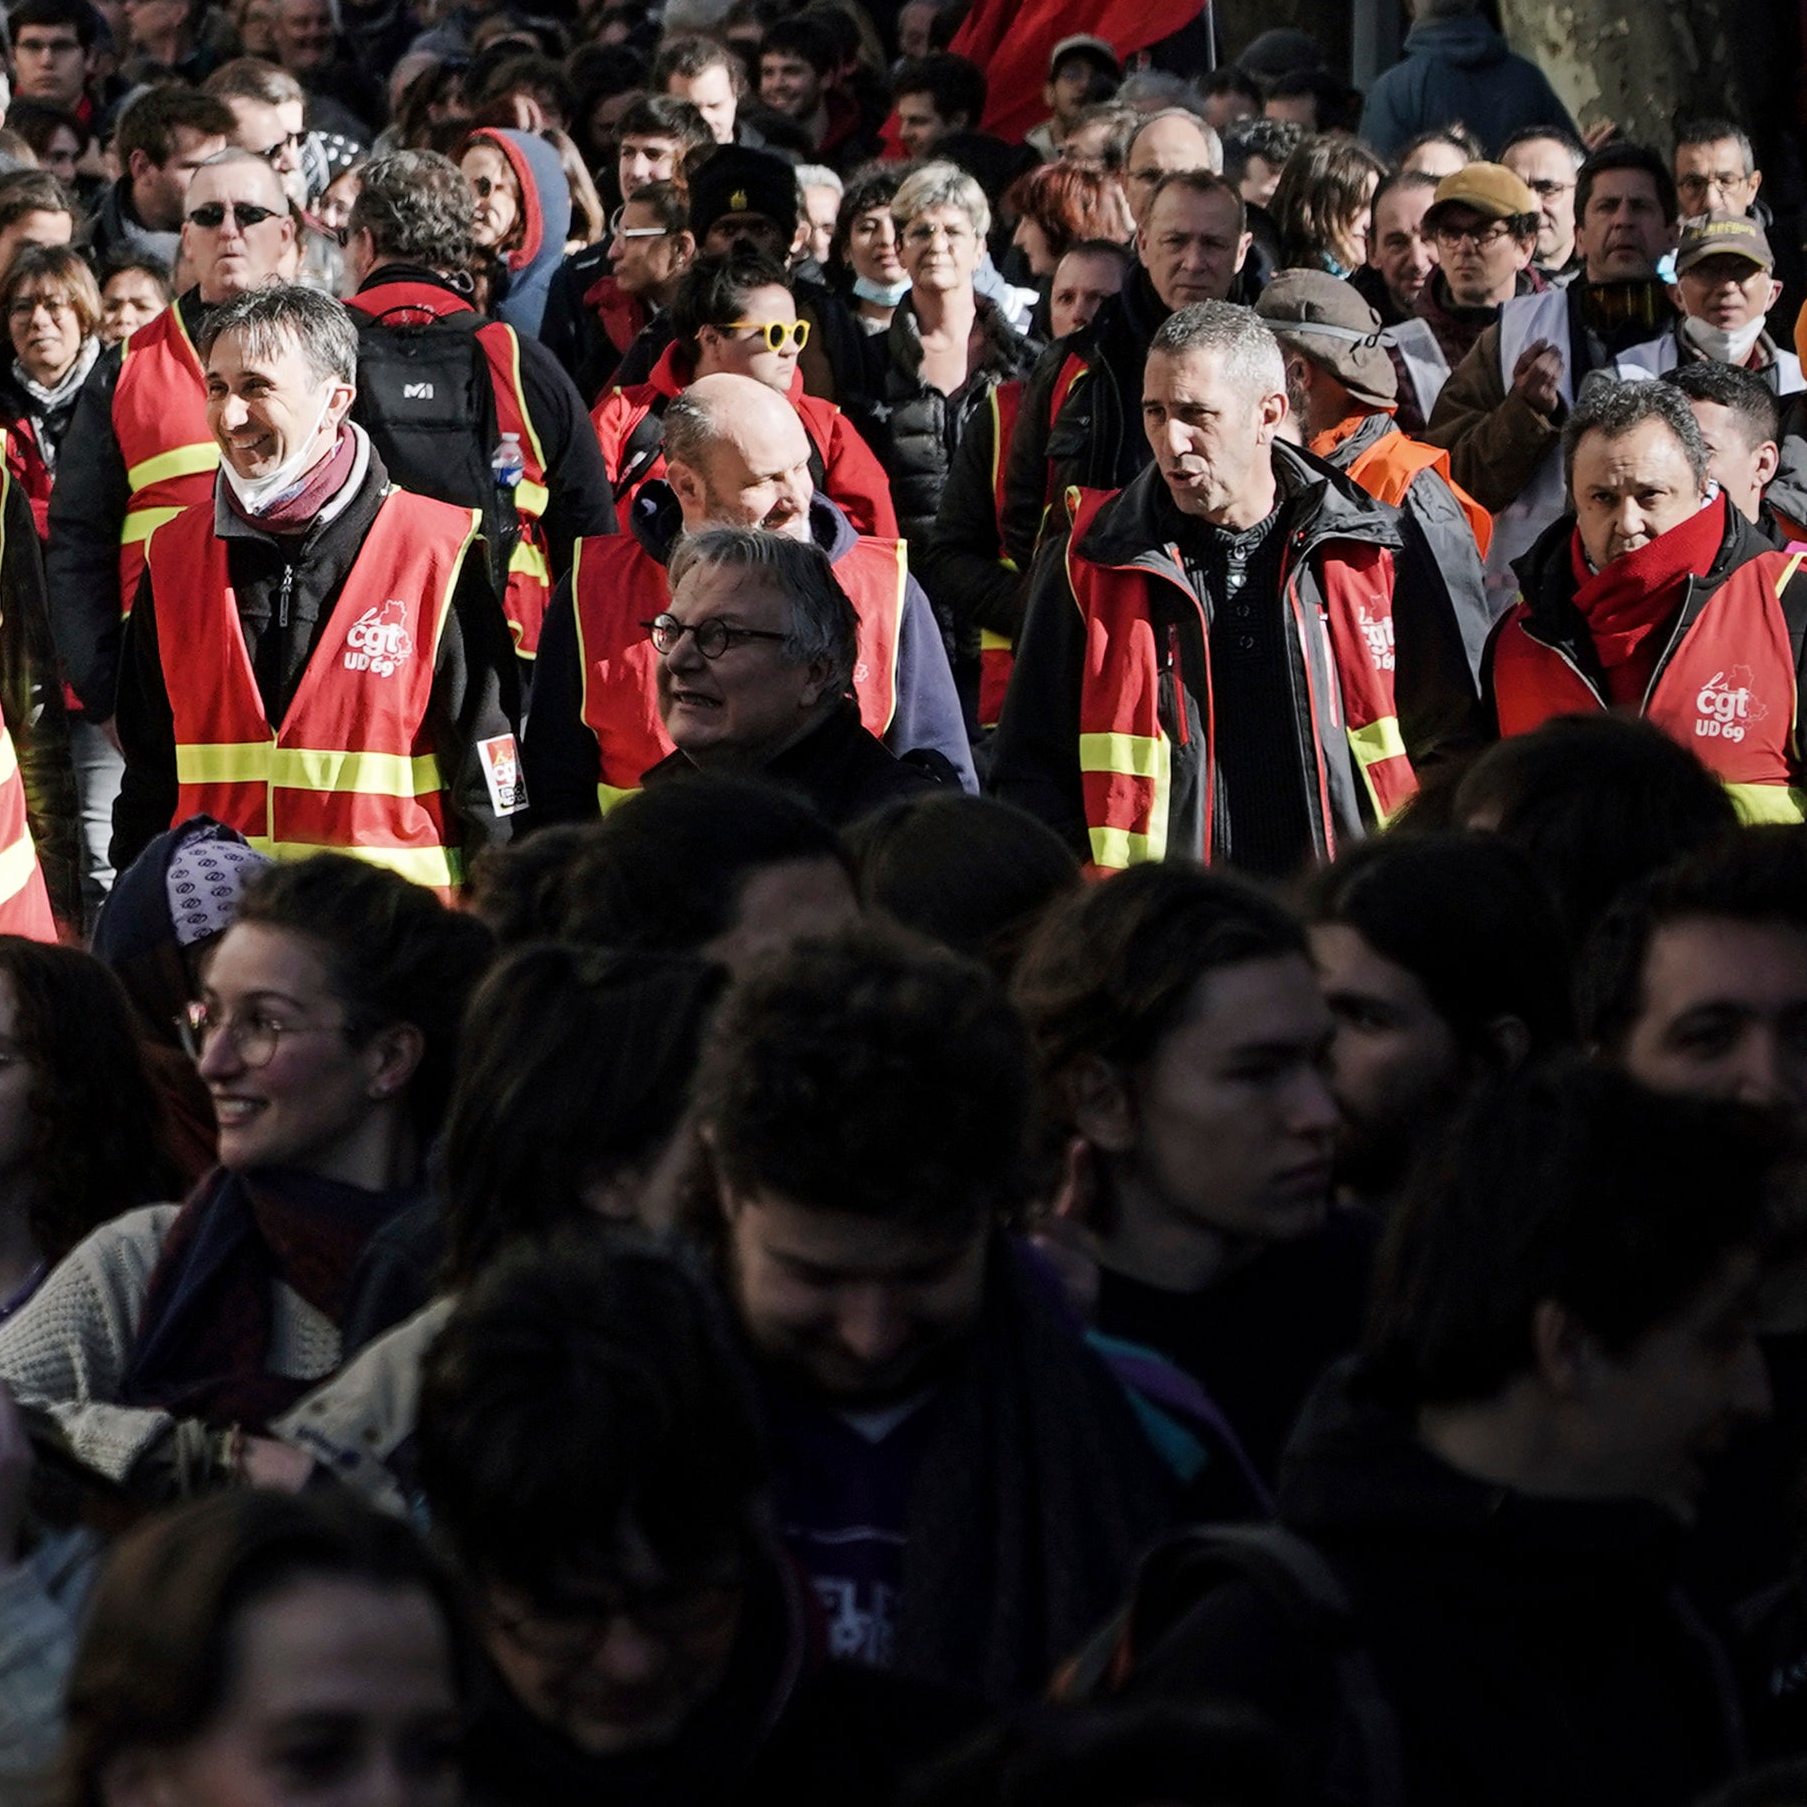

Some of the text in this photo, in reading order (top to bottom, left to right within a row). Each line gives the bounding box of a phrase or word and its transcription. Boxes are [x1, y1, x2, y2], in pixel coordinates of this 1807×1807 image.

[347, 623, 399, 657] cgt
[344, 652, 394, 678] UD 69
[1696, 687, 1749, 723] cgt
[1695, 719, 1746, 743] UD 69
